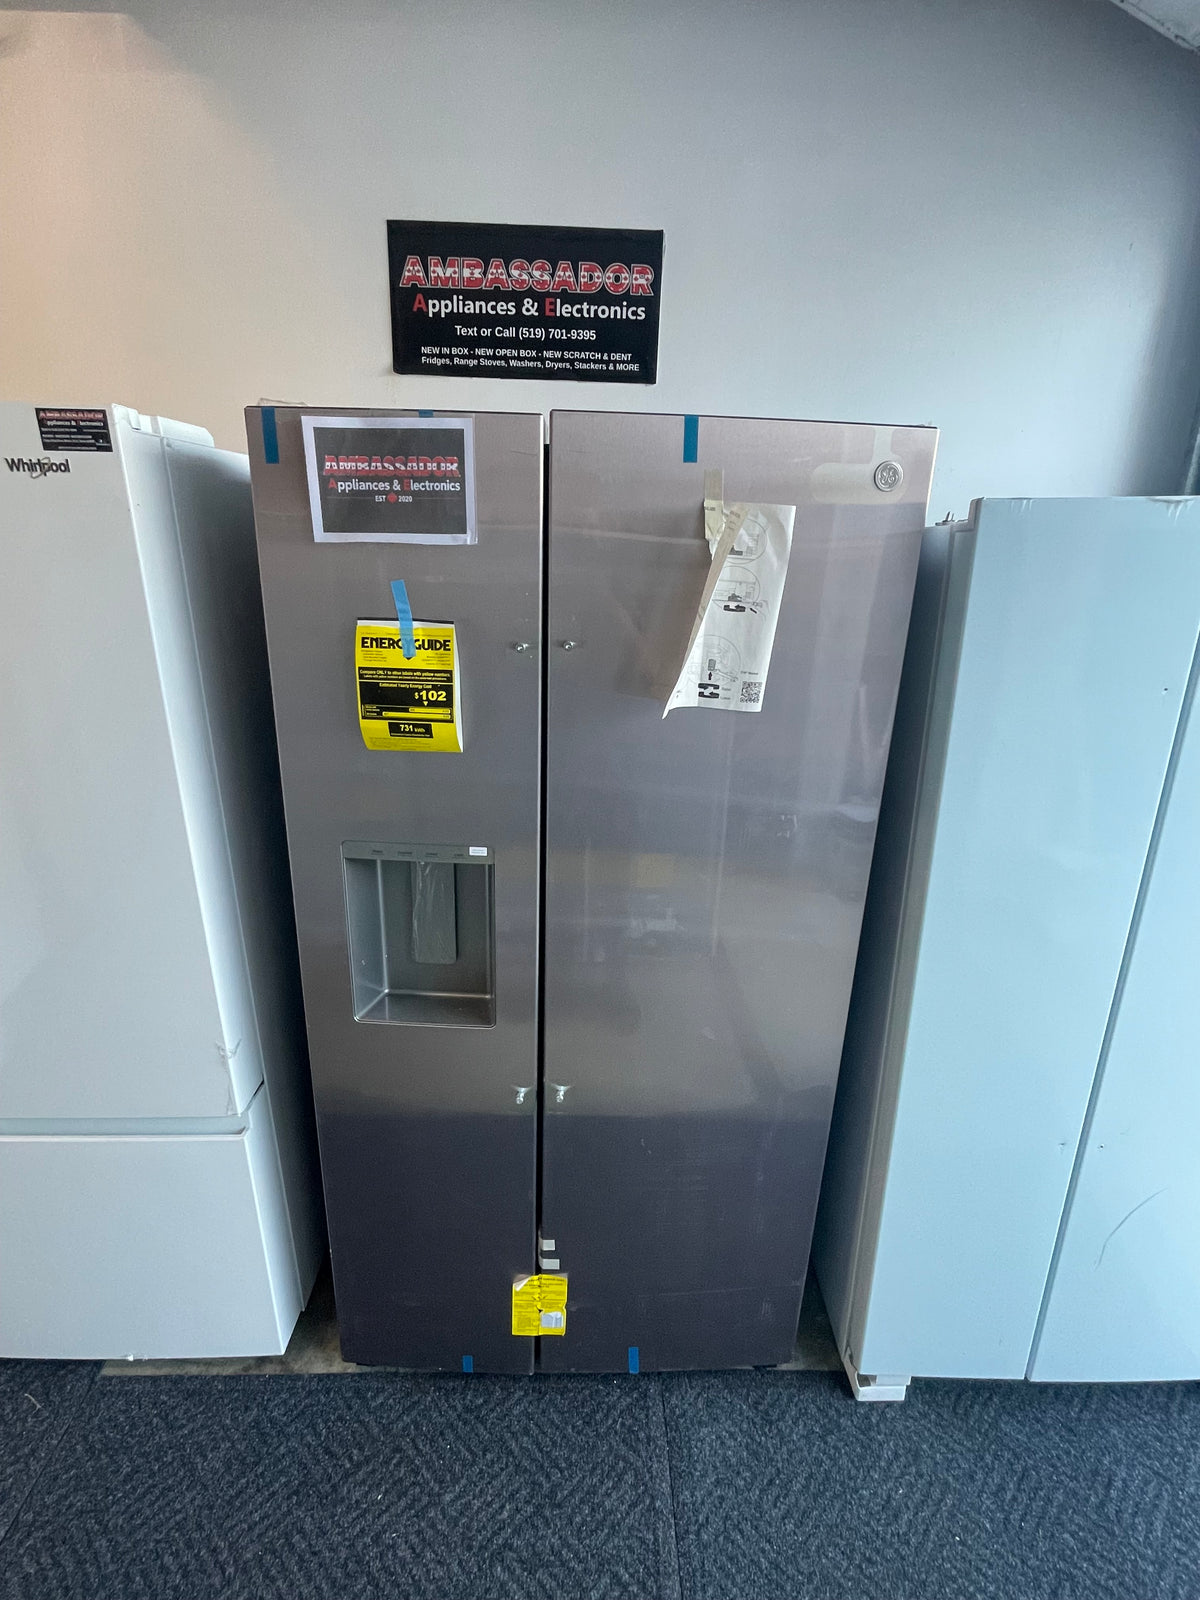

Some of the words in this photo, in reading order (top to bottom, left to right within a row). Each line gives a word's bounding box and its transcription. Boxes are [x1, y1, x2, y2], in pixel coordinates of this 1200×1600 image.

[399, 255, 654, 296] AMBASSADOR
[412, 293, 516, 318] Appliances
[521, 297, 539, 316] &
[544, 297, 646, 320] Electronics
[454, 325, 478, 336] Text
[480, 327, 492, 337] or
[494, 326, 516, 337] Call
[518, 327, 546, 341] (519)
[548, 328, 597, 340] 701-9395
[421, 346, 440, 354] NEW
[441, 347, 450, 355] IN
[451, 347, 469, 355] BOX
[475, 348, 494, 356] NEW
[495, 348, 518, 357] OPEN
[519, 349, 537, 357] BOX
[543, 350, 562, 358] NEW
[563, 350, 601, 360] SCRATCH
[602, 352, 609, 360] &
[610, 353, 632, 361] DENT
[421, 356, 452, 366] Fridges,
[453, 357, 478, 367] Range
[479, 357, 508, 367] Stoves,
[509, 359, 544, 368] Washers,
[545, 360, 573, 370] Dryers,
[574, 361, 607, 370] Stackers
[615, 363, 640, 371] MORE
[4, 457, 71, 477] Whirlpool
[323, 455, 461, 477] AMBASSADOR
[328, 478, 390, 493] Appliances
[392, 480, 401, 491] &
[403, 479, 461, 492] Electronics
[414, 690, 447, 701] $102
[399, 724, 414, 732] 731
